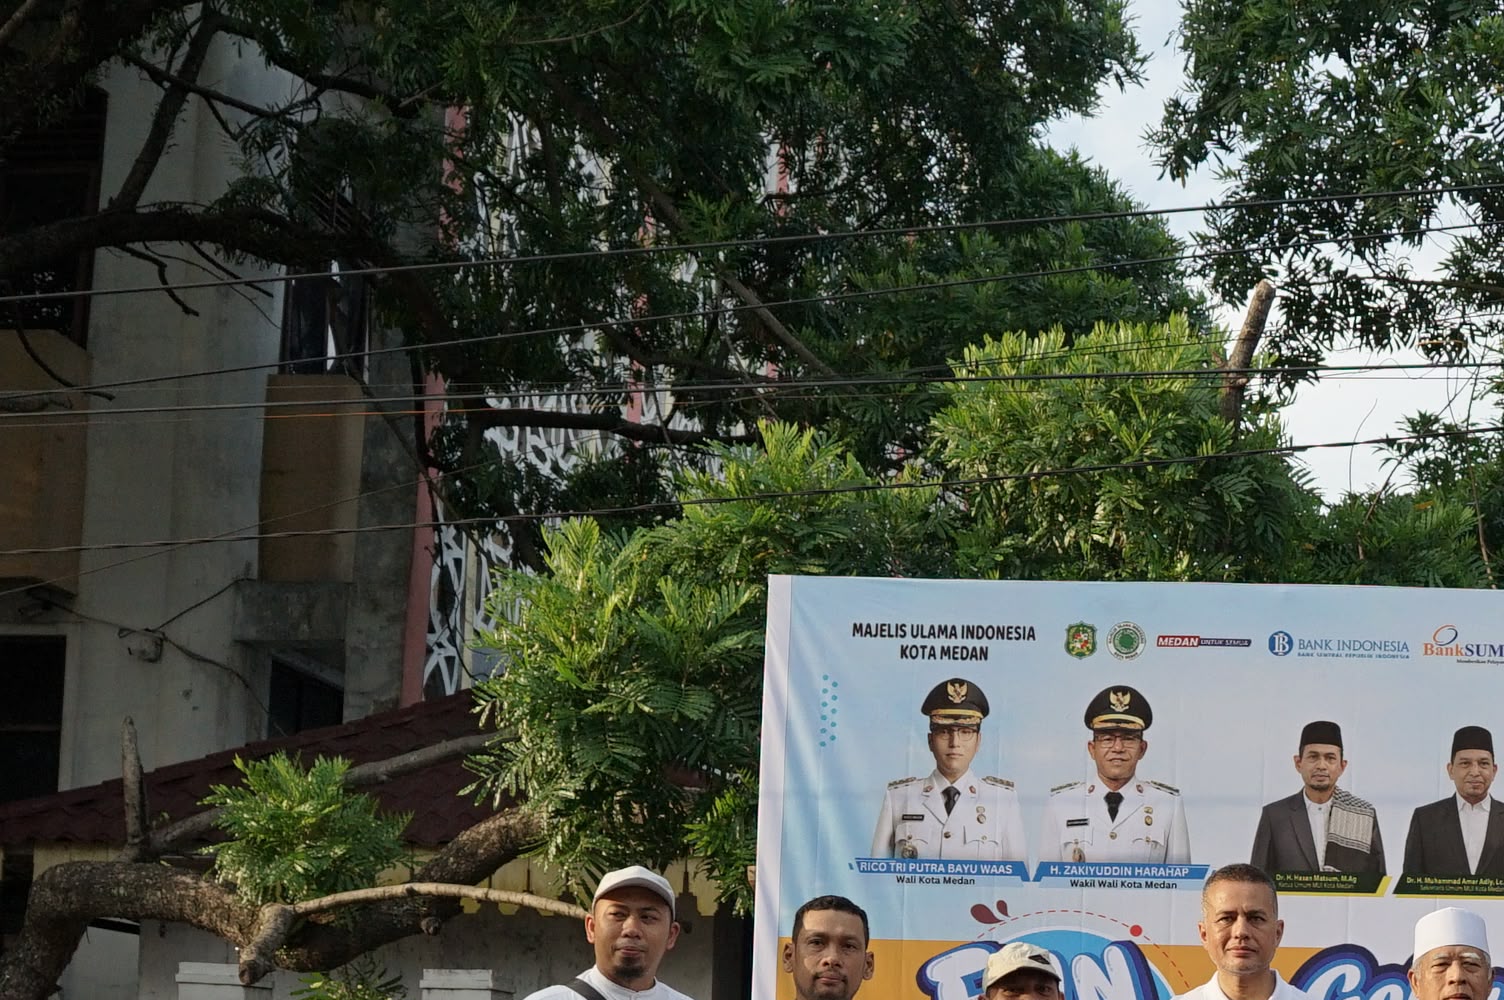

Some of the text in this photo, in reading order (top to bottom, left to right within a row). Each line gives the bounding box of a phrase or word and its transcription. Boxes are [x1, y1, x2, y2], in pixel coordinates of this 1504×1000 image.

[852, 622, 1036, 641] MAJELIS ULAMA INDONESIA
[1158, 637, 1198, 646] MEDAN
[1298, 639, 1409, 652] BANK INDONESIA
[900, 644, 988, 661] KOTA MEDAN
[860, 861, 1013, 874] RICO TRI PUTRA BAYU WAAS
[1050, 866, 1189, 877] H. ZAKIYUDDIN HARAHAP
[896, 875, 975, 885] Wali Kota Medan
[1070, 879, 1177, 890] Wakil Wali Kota Medan
